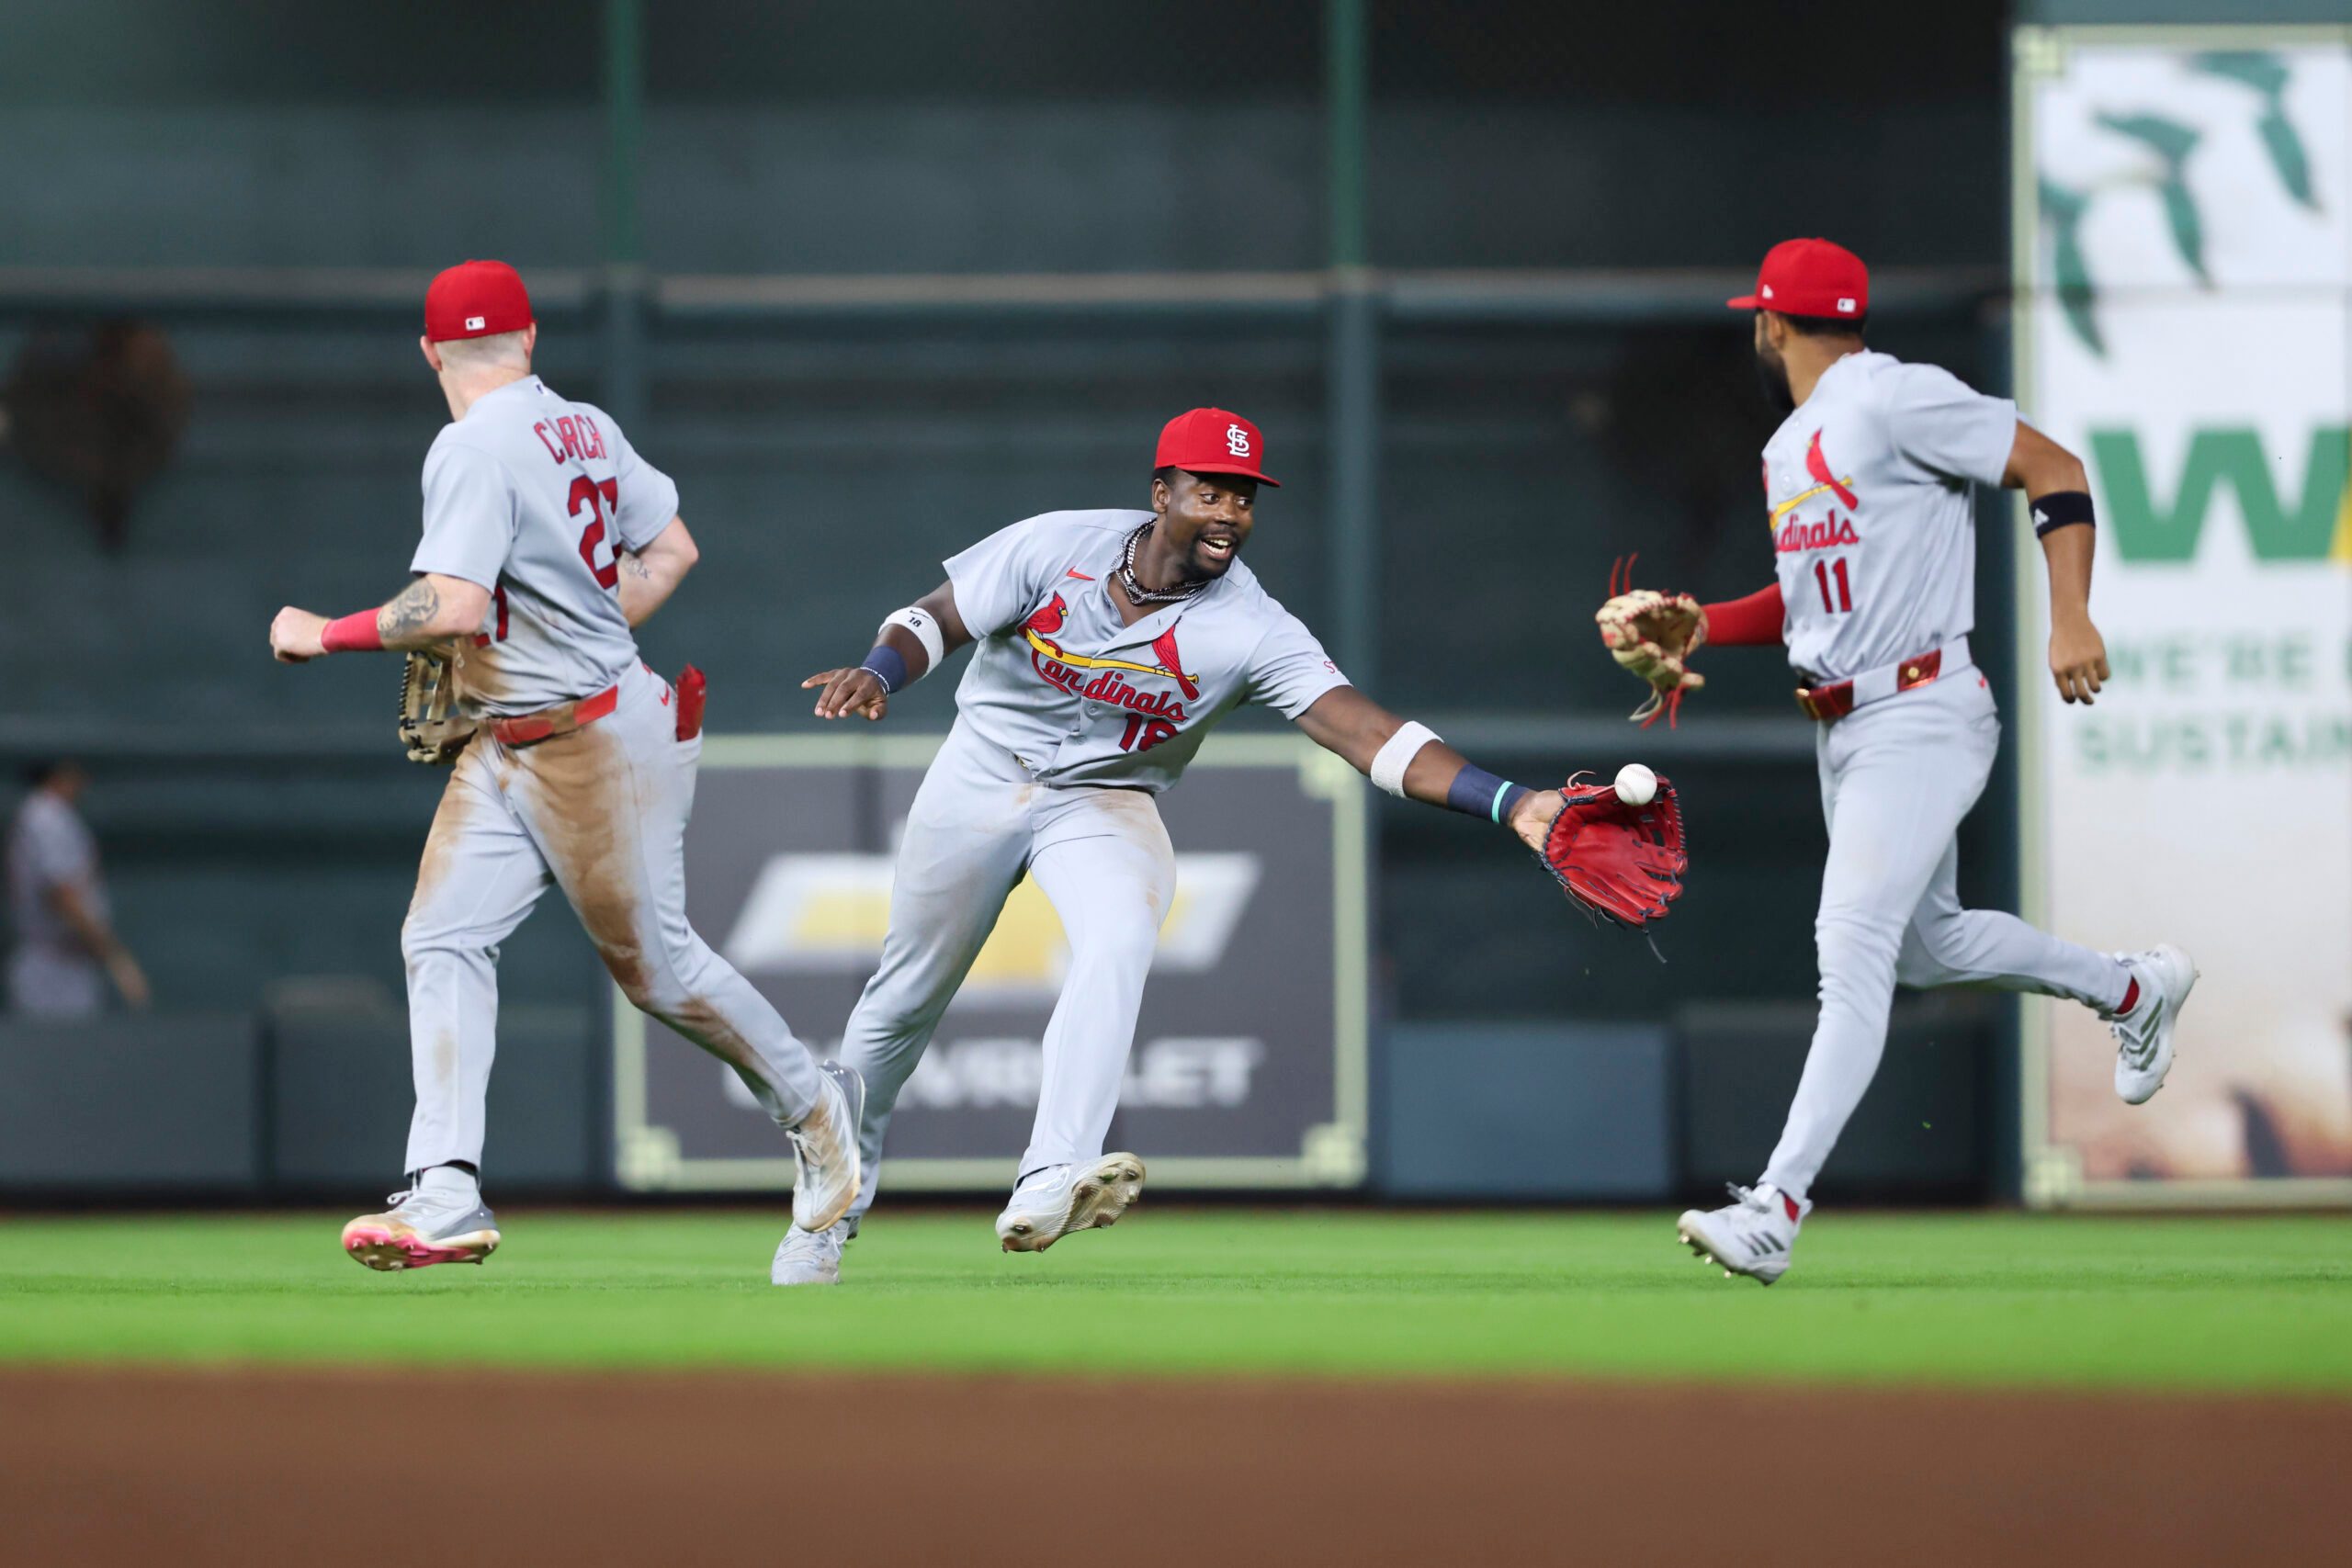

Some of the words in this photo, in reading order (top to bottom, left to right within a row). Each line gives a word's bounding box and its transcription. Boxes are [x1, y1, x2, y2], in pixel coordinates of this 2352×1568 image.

[1774, 508, 1860, 553] dinals
[2084, 426, 2352, 566] W
[1815, 557, 1852, 614] 11
[1031, 638, 1190, 723] Cardinals
